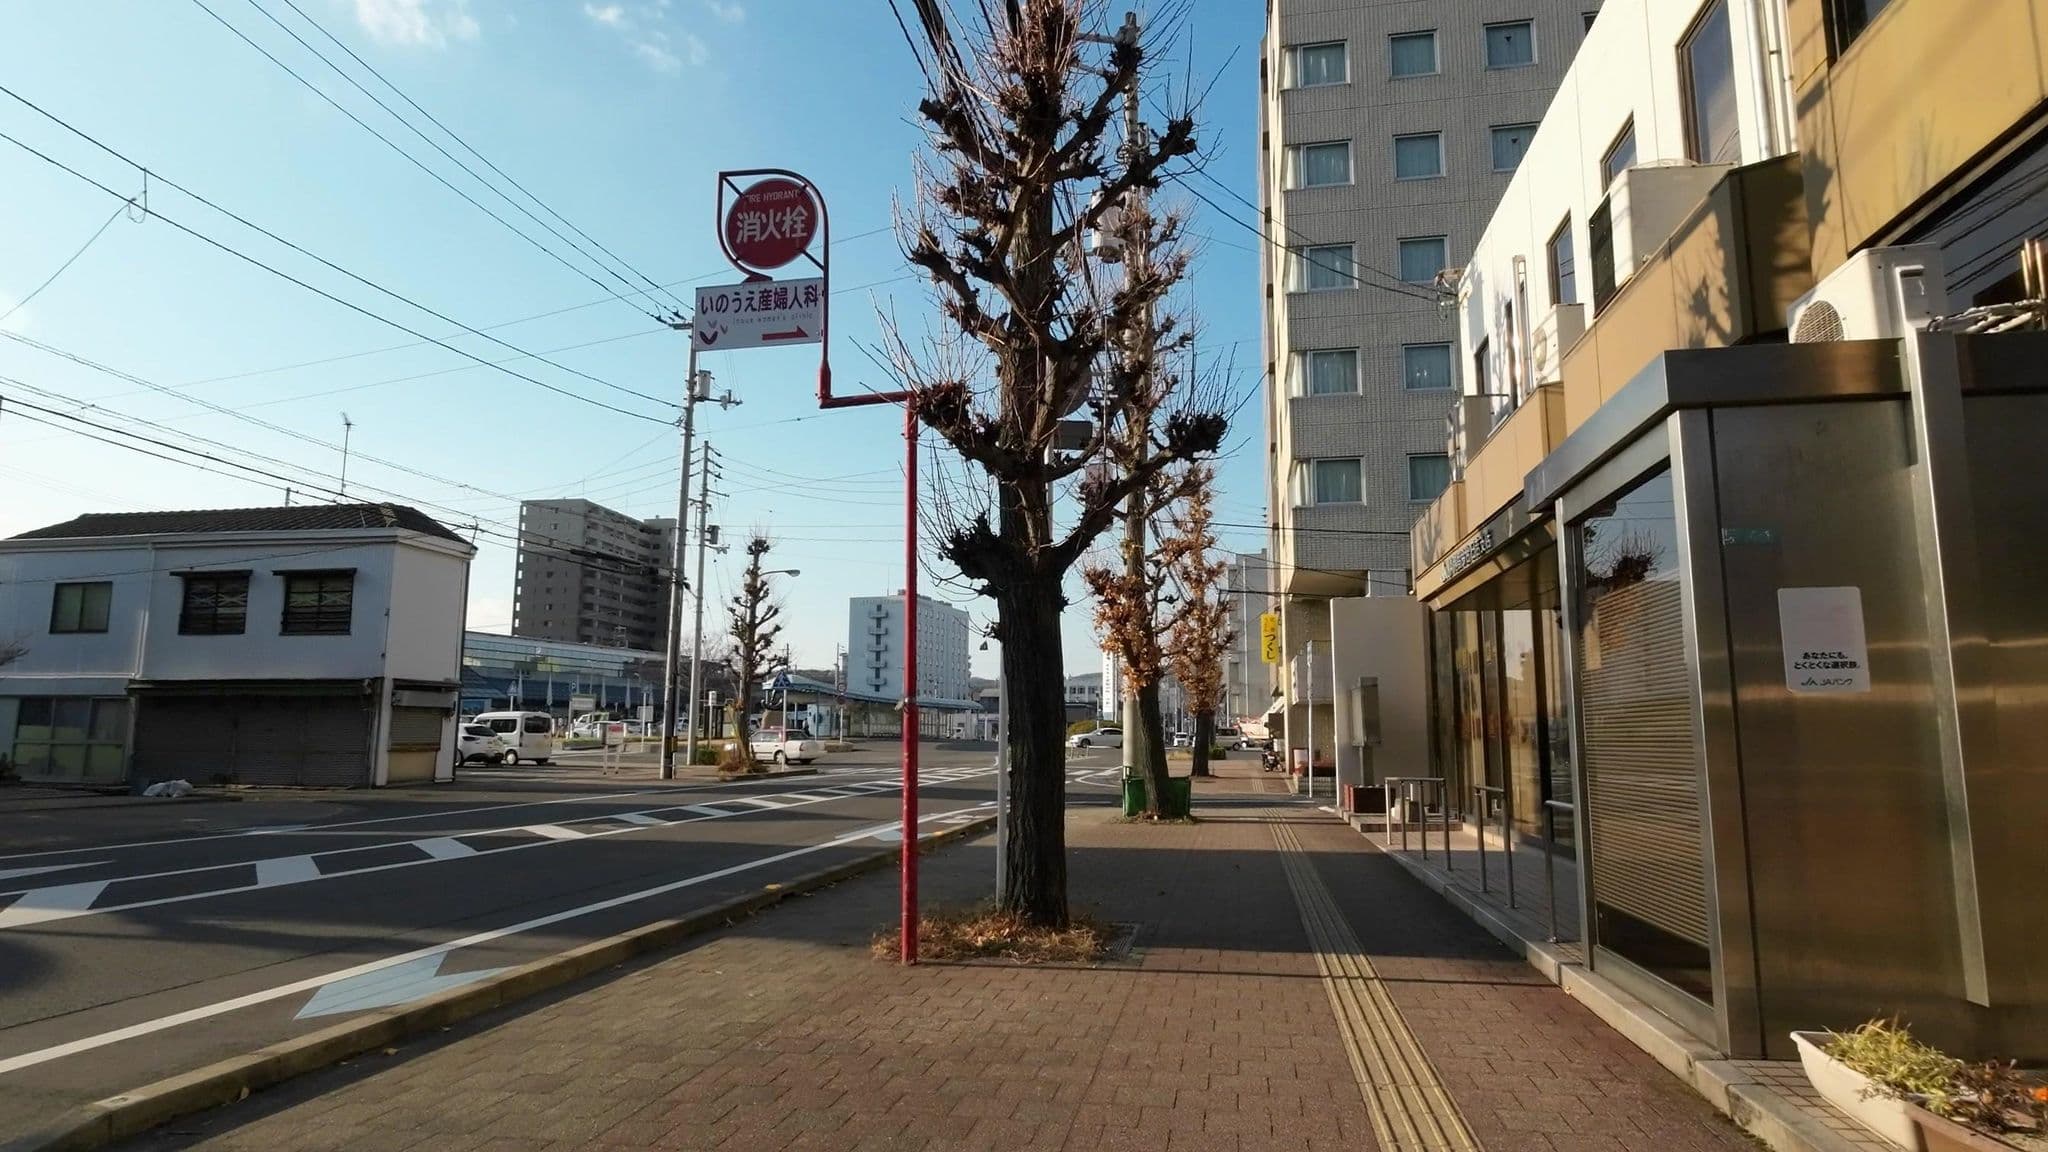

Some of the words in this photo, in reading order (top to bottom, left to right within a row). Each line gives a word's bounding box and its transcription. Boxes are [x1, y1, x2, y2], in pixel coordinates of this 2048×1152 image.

[763, 190, 799, 201] HYDRANT
[736, 205, 808, 243] 消火栓
[701, 284, 819, 314] いのうえ産婦人科
[1264, 633, 1276, 660] つくし
